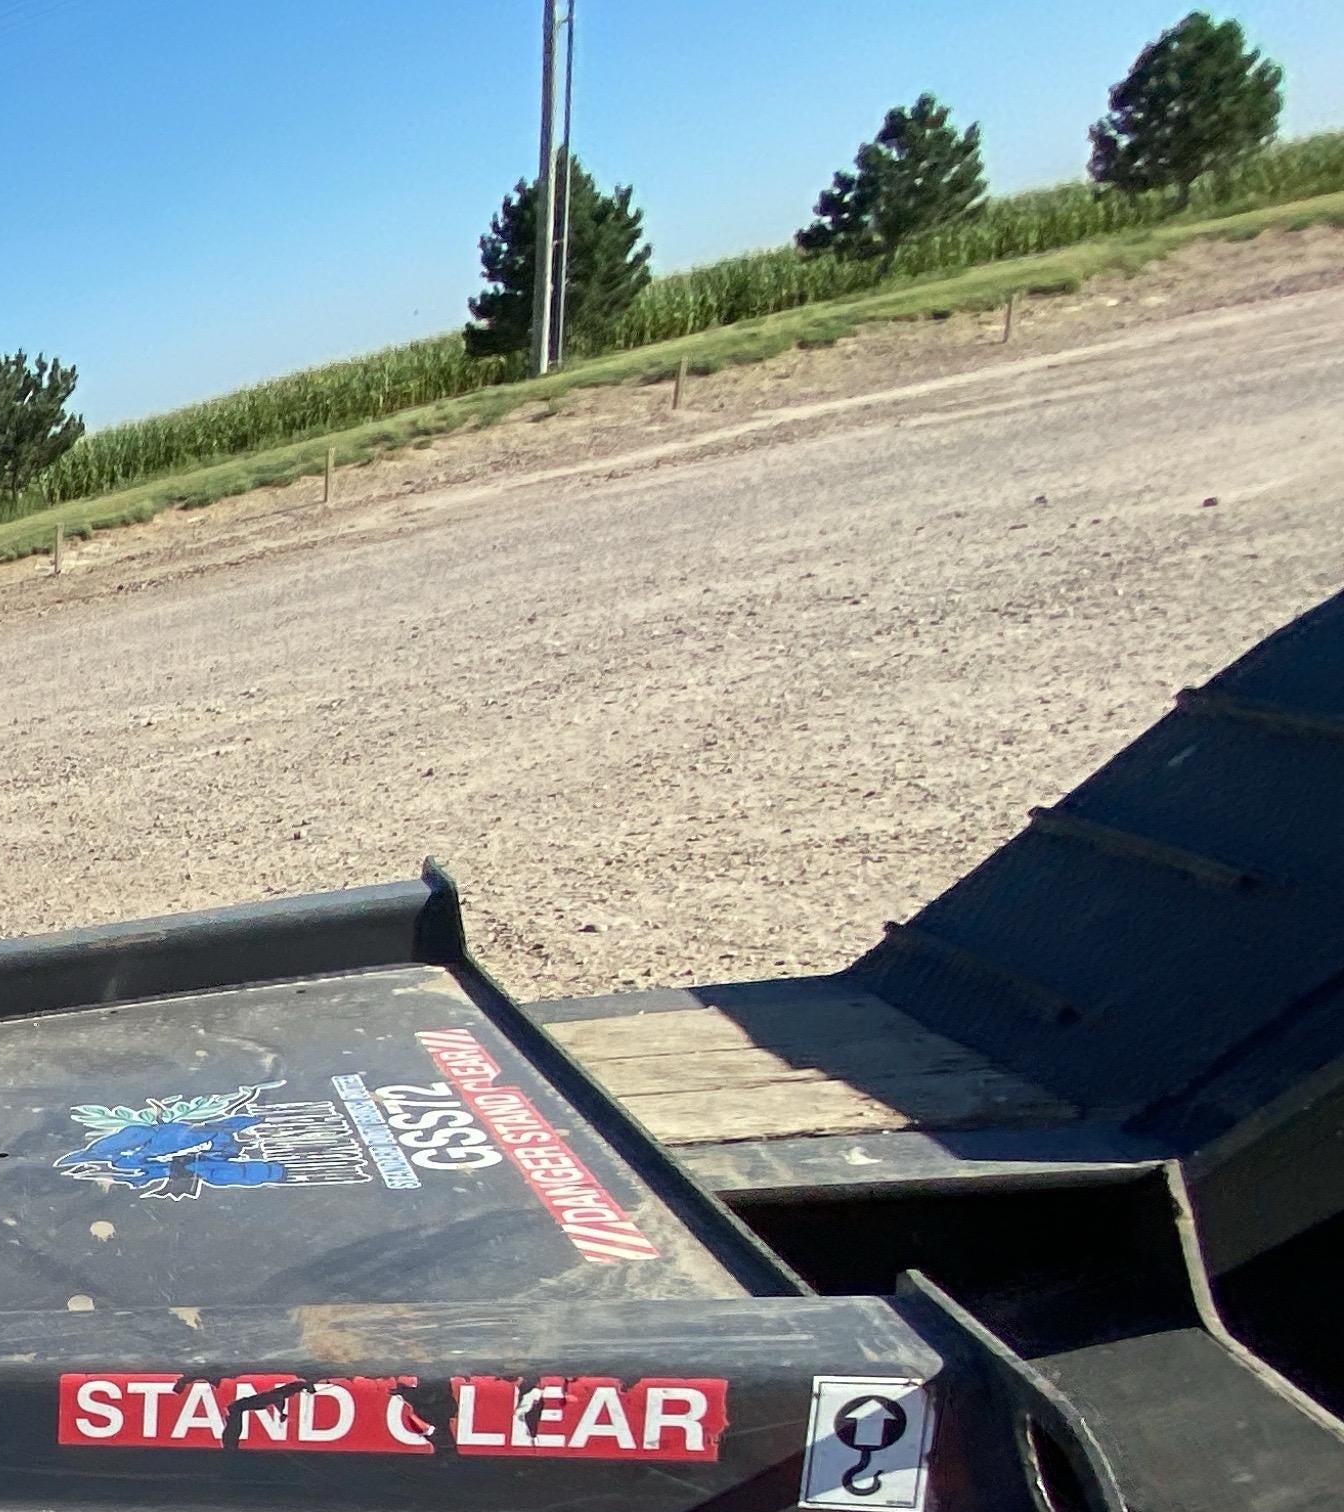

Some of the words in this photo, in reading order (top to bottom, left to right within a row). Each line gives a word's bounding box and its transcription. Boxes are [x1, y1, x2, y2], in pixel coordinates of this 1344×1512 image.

[375, 1082, 503, 1170] GSS72
[475, 1094, 552, 1145] STAND
[514, 1146, 619, 1224] DANGER
[75, 1380, 357, 1443] STAND
